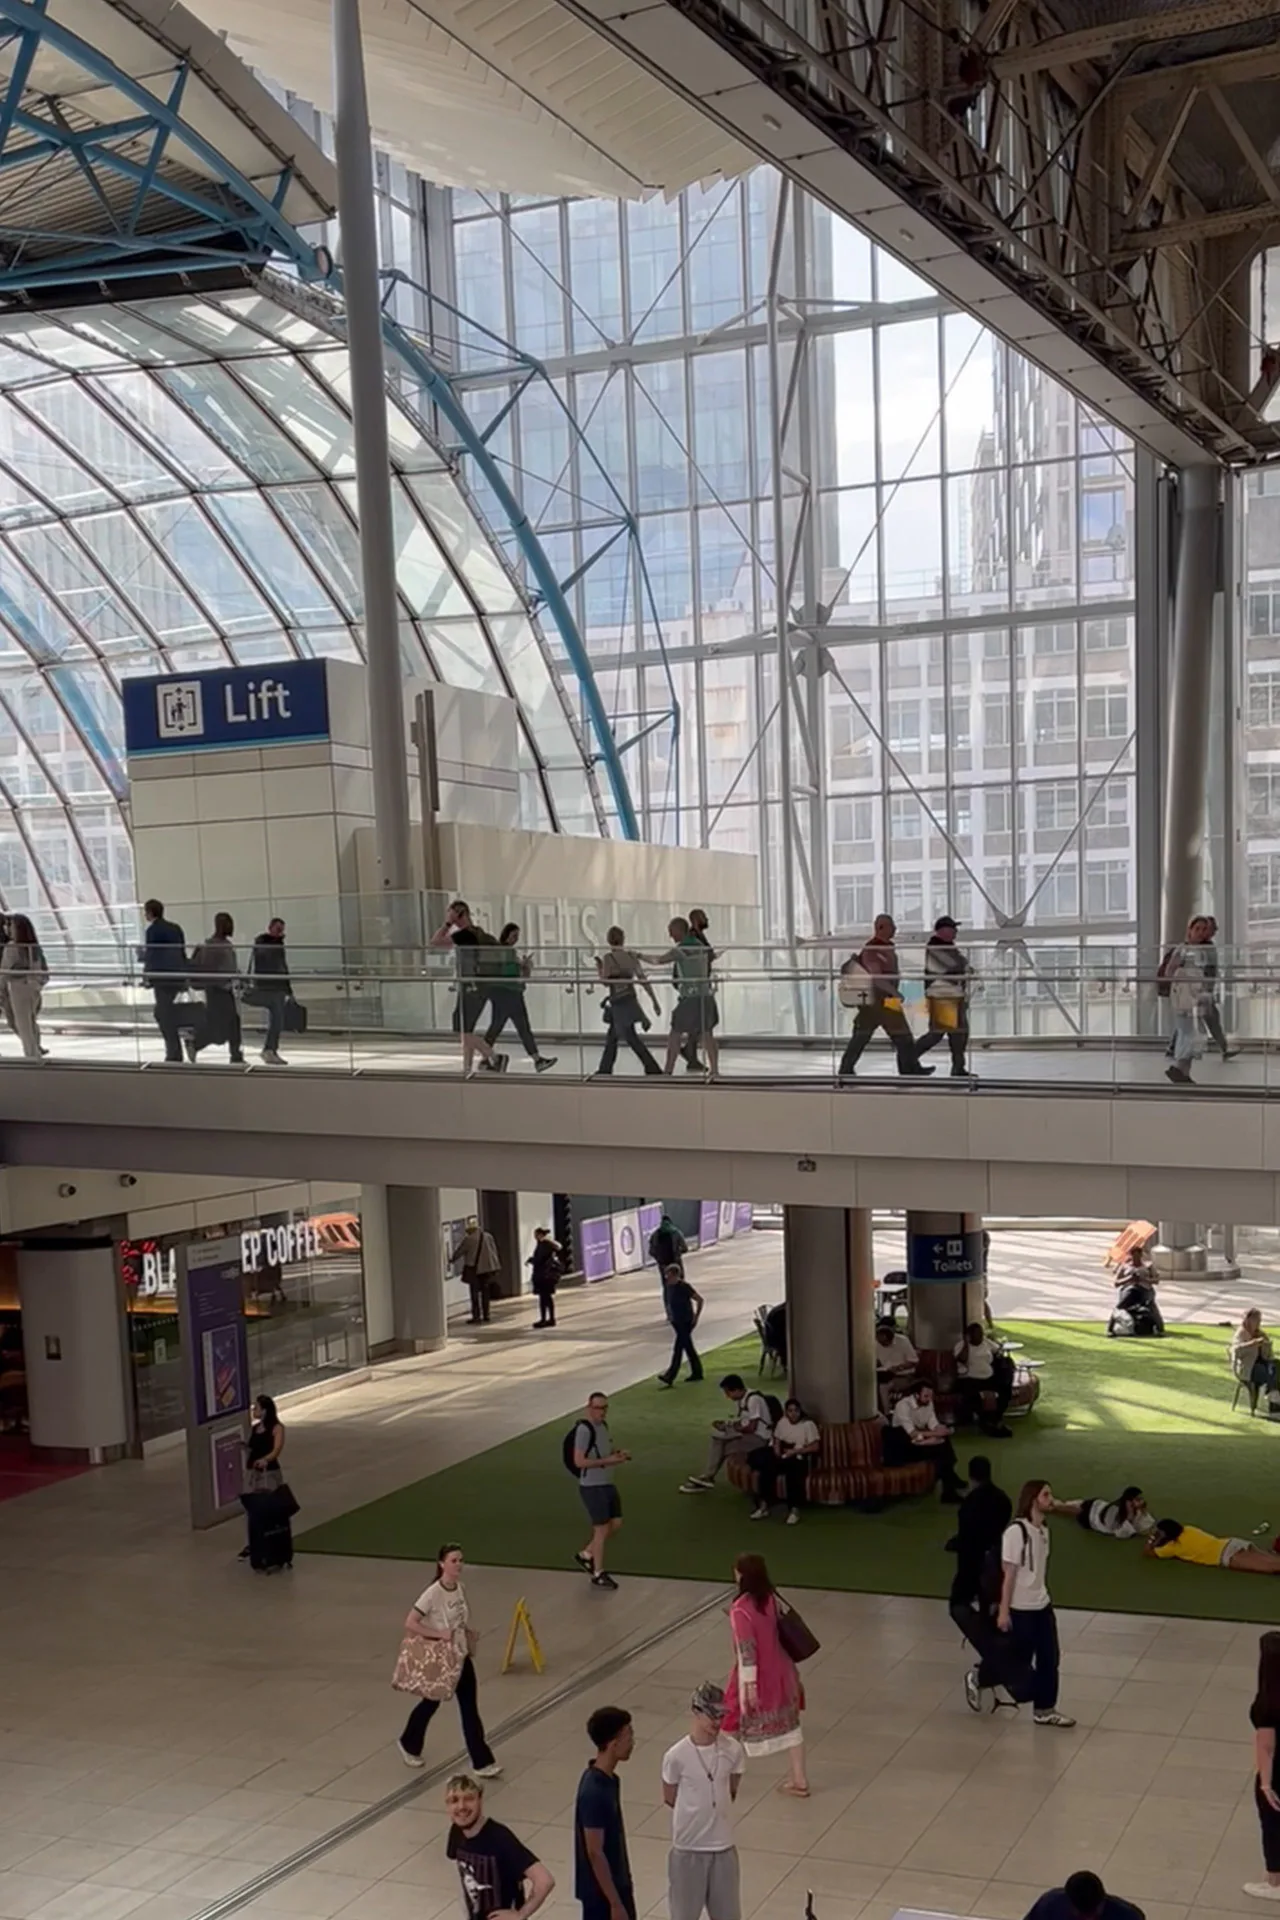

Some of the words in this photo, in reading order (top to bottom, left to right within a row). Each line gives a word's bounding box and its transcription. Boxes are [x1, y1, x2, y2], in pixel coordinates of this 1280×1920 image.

[224, 679, 292, 723] Lift
[266, 1219, 323, 1267] COFFEE
[932, 1259, 973, 1272] Toilets
